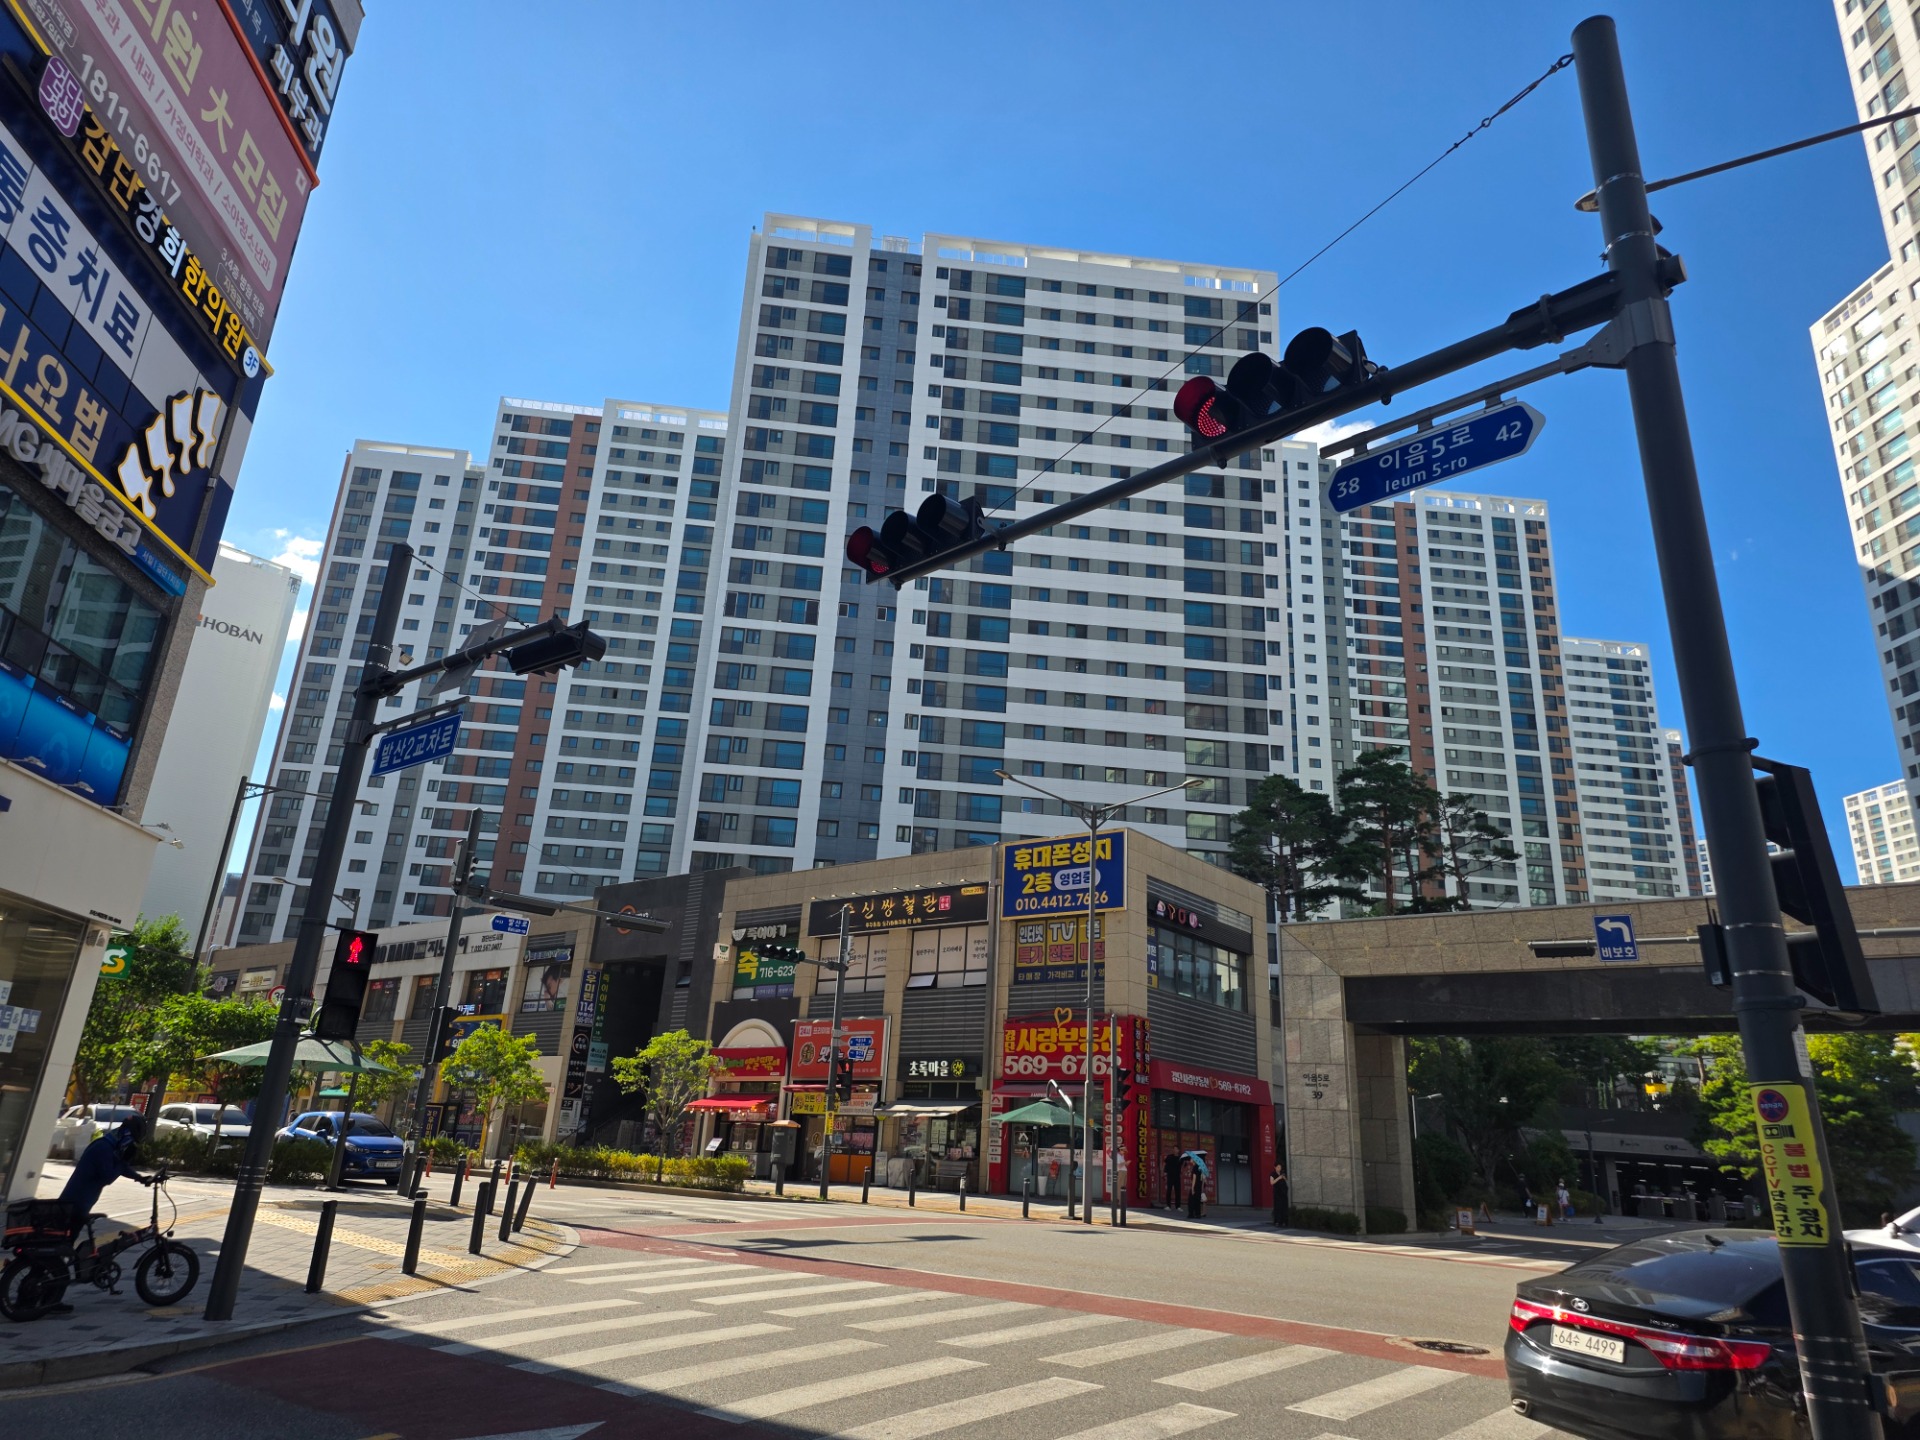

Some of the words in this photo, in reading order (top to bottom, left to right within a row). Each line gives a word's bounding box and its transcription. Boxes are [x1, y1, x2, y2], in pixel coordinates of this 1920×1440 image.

[270, 43, 323, 152] 피부과
[81, 53, 182, 207] 1811-6617
[130, 45, 156, 91] 내과
[164, 101, 215, 182] 가정의학과
[221, 194, 272, 276] 소아청소년과
[232, 129, 288, 243] 모집
[244, 350, 260, 372] 3F
[1337, 477, 1361, 499] 38
[1378, 425, 1474, 470] 이음5로
[1495, 420, 1523, 442] 42
[1384, 470, 1427, 493] Ieum
[1431, 456, 1468, 477] 5-ro
[202, 616, 263, 645] HOBAN
[379, 724, 454, 769] 발산2교차로
[1013, 838, 1112, 870] 휴대폰성지
[1022, 871, 1052, 895] 2층
[747, 924, 787, 940] 죽이야기
[1019, 924, 1044, 943] 인터넷
[1050, 920, 1074, 941] TV
[1018, 945, 1043, 964] 특가
[1049, 943, 1075, 962] 전문
[1601, 946, 1636, 958] 비보호
[737, 951, 759, 980] 죽
[1047, 969, 1074, 979] 가격비교
[579, 1002, 594, 1012] 114
[1005, 1030, 1015, 1053] 검단
[1017, 1026, 1123, 1053] 사랑부동산
[817, 1046, 844, 1062] 맛는
[1004, 1054, 1122, 1075] 569-6762
[909, 1060, 949, 1077] 초록마을
[1302, 1073, 1331, 1082] 이음5로
[1218, 1080, 1252, 1095] 569-6762
[1311, 1090, 1323, 1099] 39
[1783, 1143, 1811, 1179] 불법
[1558, 1330, 1581, 1346] 64수
[1585, 1336, 1617, 1356] 4499
